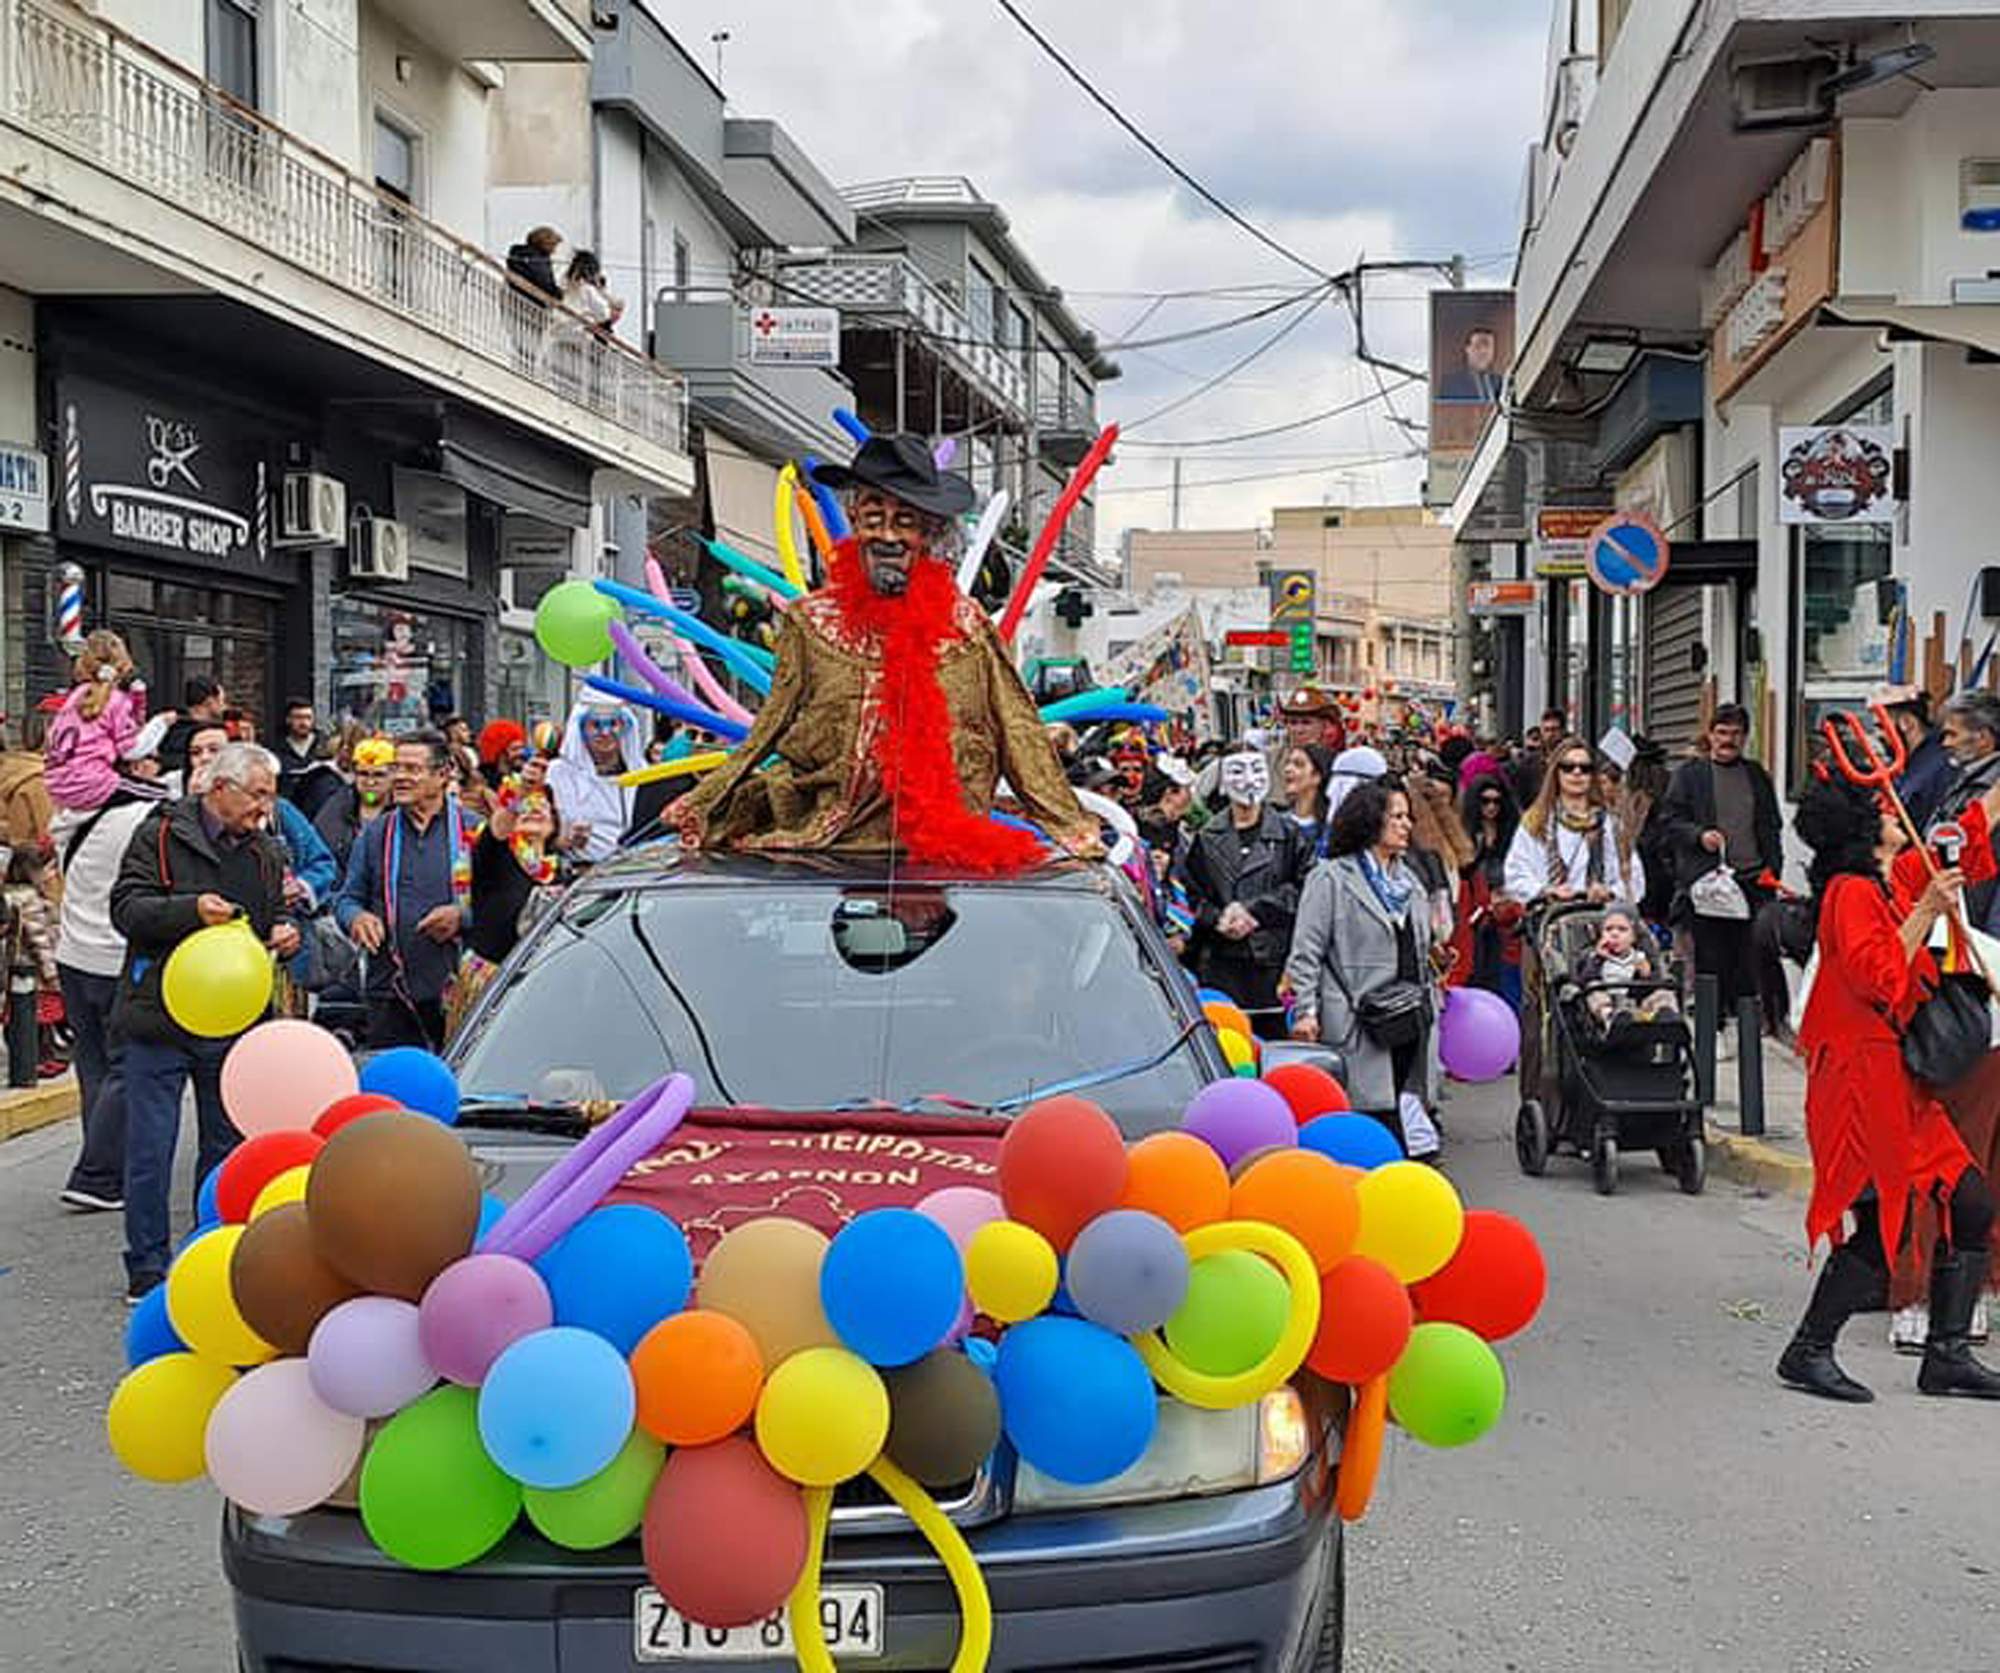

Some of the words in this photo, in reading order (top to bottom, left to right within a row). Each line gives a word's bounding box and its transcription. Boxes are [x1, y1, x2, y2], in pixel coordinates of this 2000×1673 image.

[111, 499, 184, 549] BARBER
[187, 519, 233, 558] SHOP
[760, 1598, 870, 1647] 894
